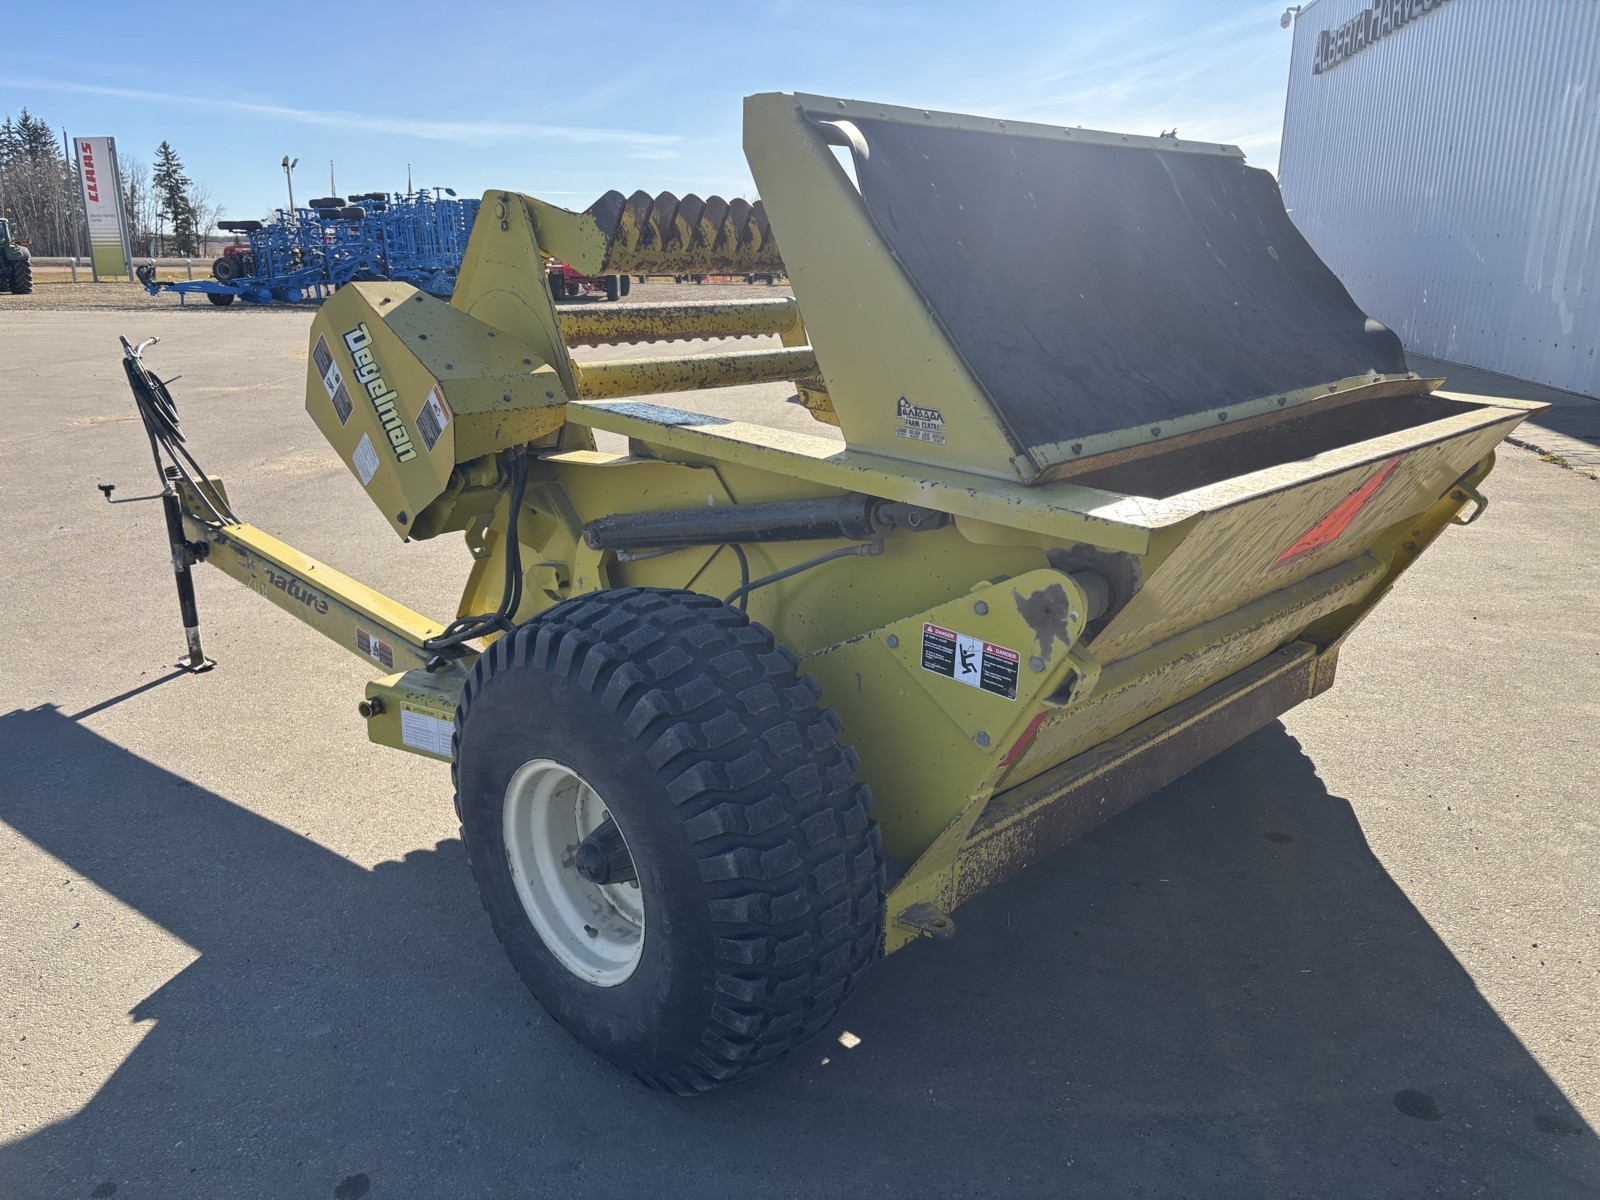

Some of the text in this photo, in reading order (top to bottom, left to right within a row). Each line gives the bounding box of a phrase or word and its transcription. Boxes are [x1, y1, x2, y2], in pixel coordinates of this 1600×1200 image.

[1312, 10, 1369, 75] ALBERTA
[81, 142, 99, 203] CLAAS
[343, 321, 418, 463] Degelman
[905, 419, 941, 431] FARM CENTRE
[934, 629, 955, 639] DANGER
[995, 648, 1017, 660] DANGER
